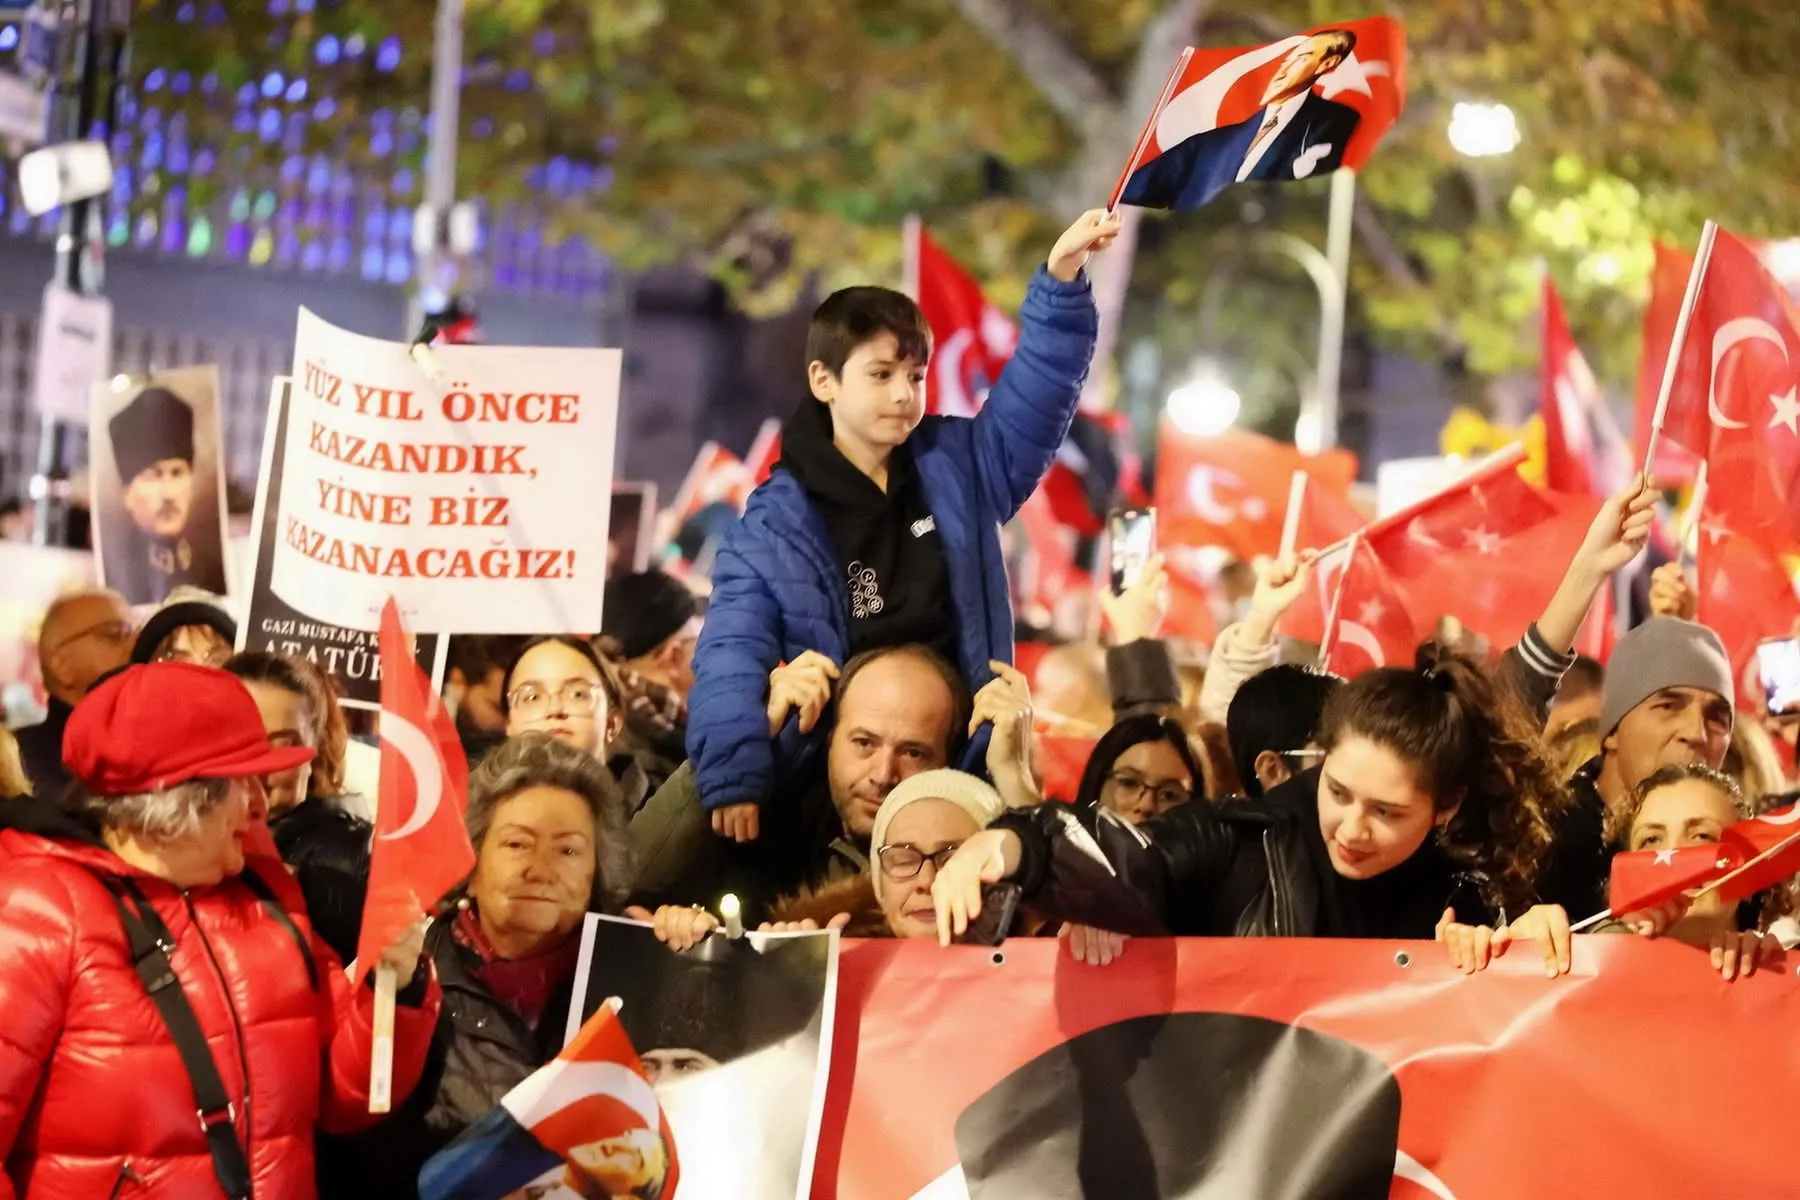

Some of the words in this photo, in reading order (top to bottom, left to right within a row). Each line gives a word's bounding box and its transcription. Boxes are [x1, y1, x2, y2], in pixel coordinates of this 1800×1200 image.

[305, 359, 342, 407] YÜZ
[352, 383, 423, 421] YIL
[441, 381, 580, 423] ÖNCE
[309, 421, 538, 479] KAZANDIK,
[318, 476, 412, 525] YİNE
[428, 486, 510, 526] BİZ
[286, 514, 576, 578] KAZANACAĞIZ!
[262, 618, 296, 634] GAZİ
[298, 622, 365, 644] MUSTAFA
[264, 640, 384, 681] TATÜR
